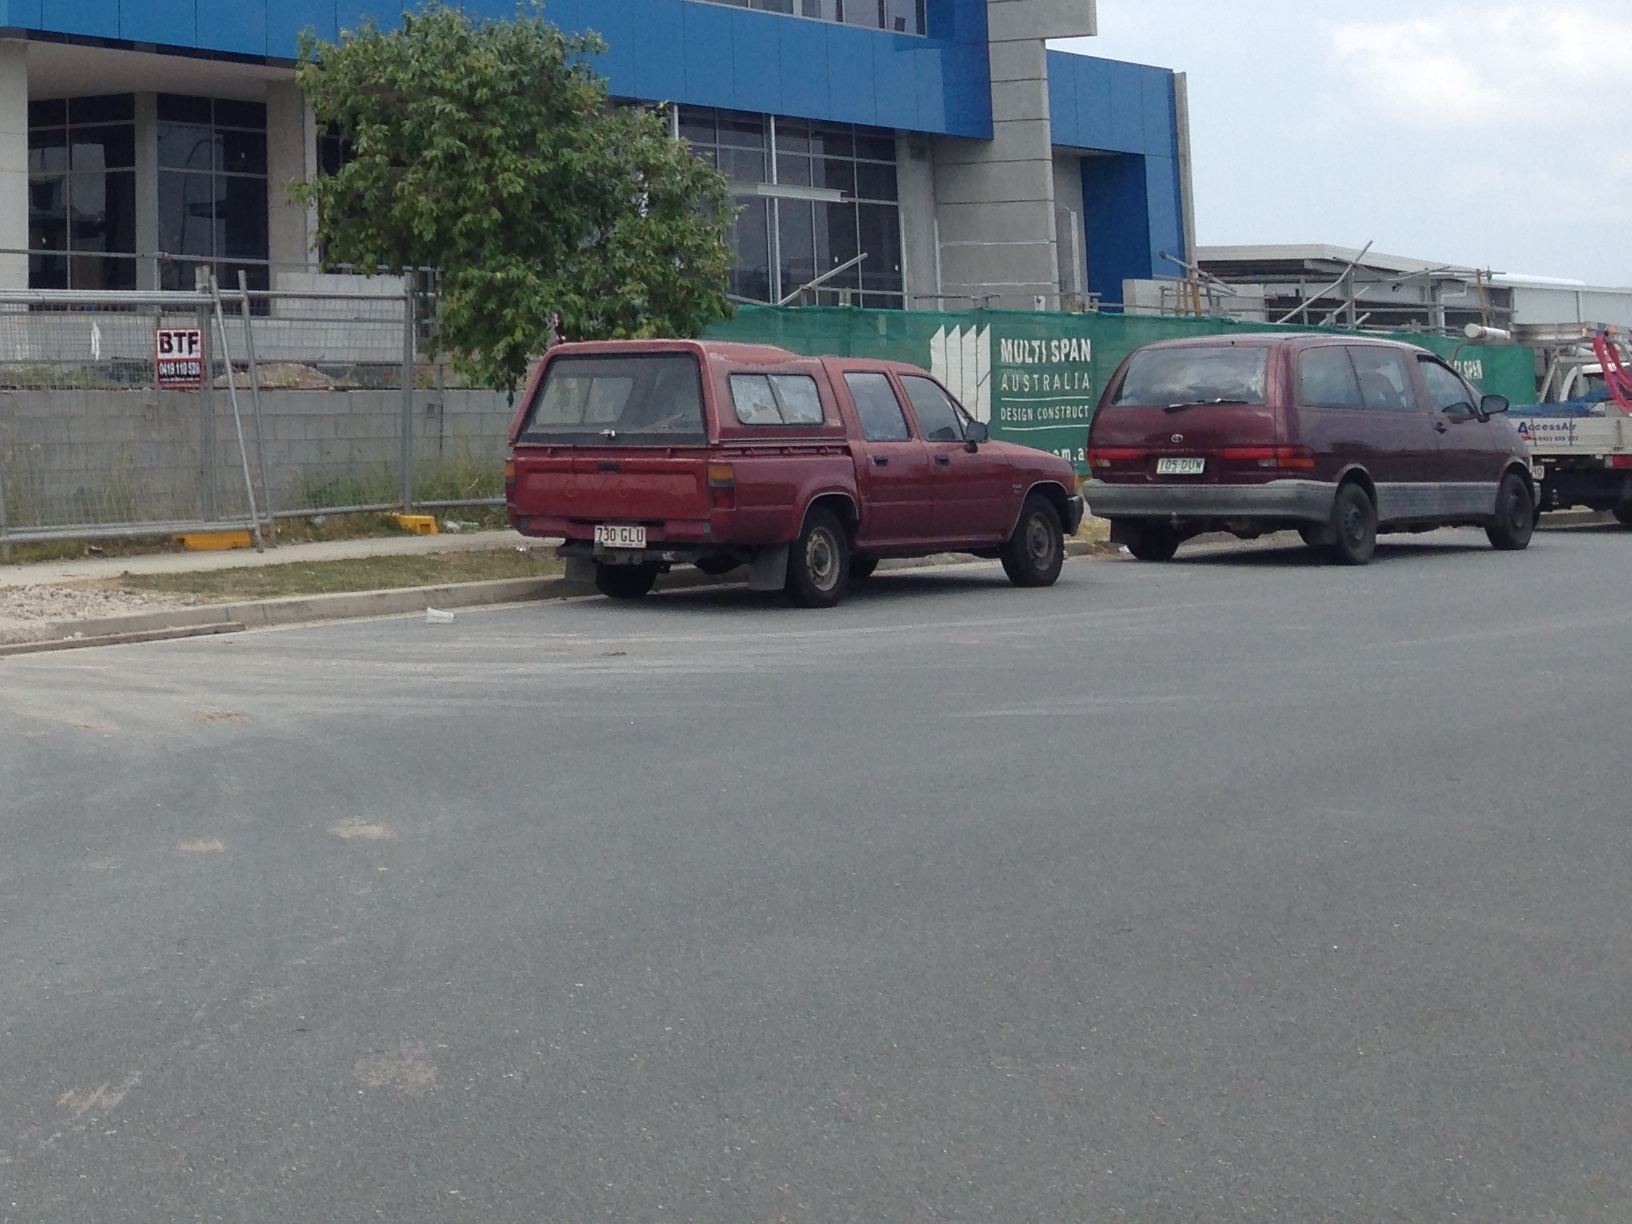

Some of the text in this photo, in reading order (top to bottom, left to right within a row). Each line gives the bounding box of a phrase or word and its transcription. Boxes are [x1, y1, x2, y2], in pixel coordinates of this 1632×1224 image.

[159, 332, 199, 355] BTF
[1000, 338, 1091, 364] MULTI SPAN
[159, 361, 175, 376] 0419
[1464, 360, 1483, 379] SPAN
[1000, 372, 1090, 392] AUSTRALIA
[1000, 405, 1089, 421] DESIGN CONSTRUCT
[596, 528, 644, 543] 730 GLU
